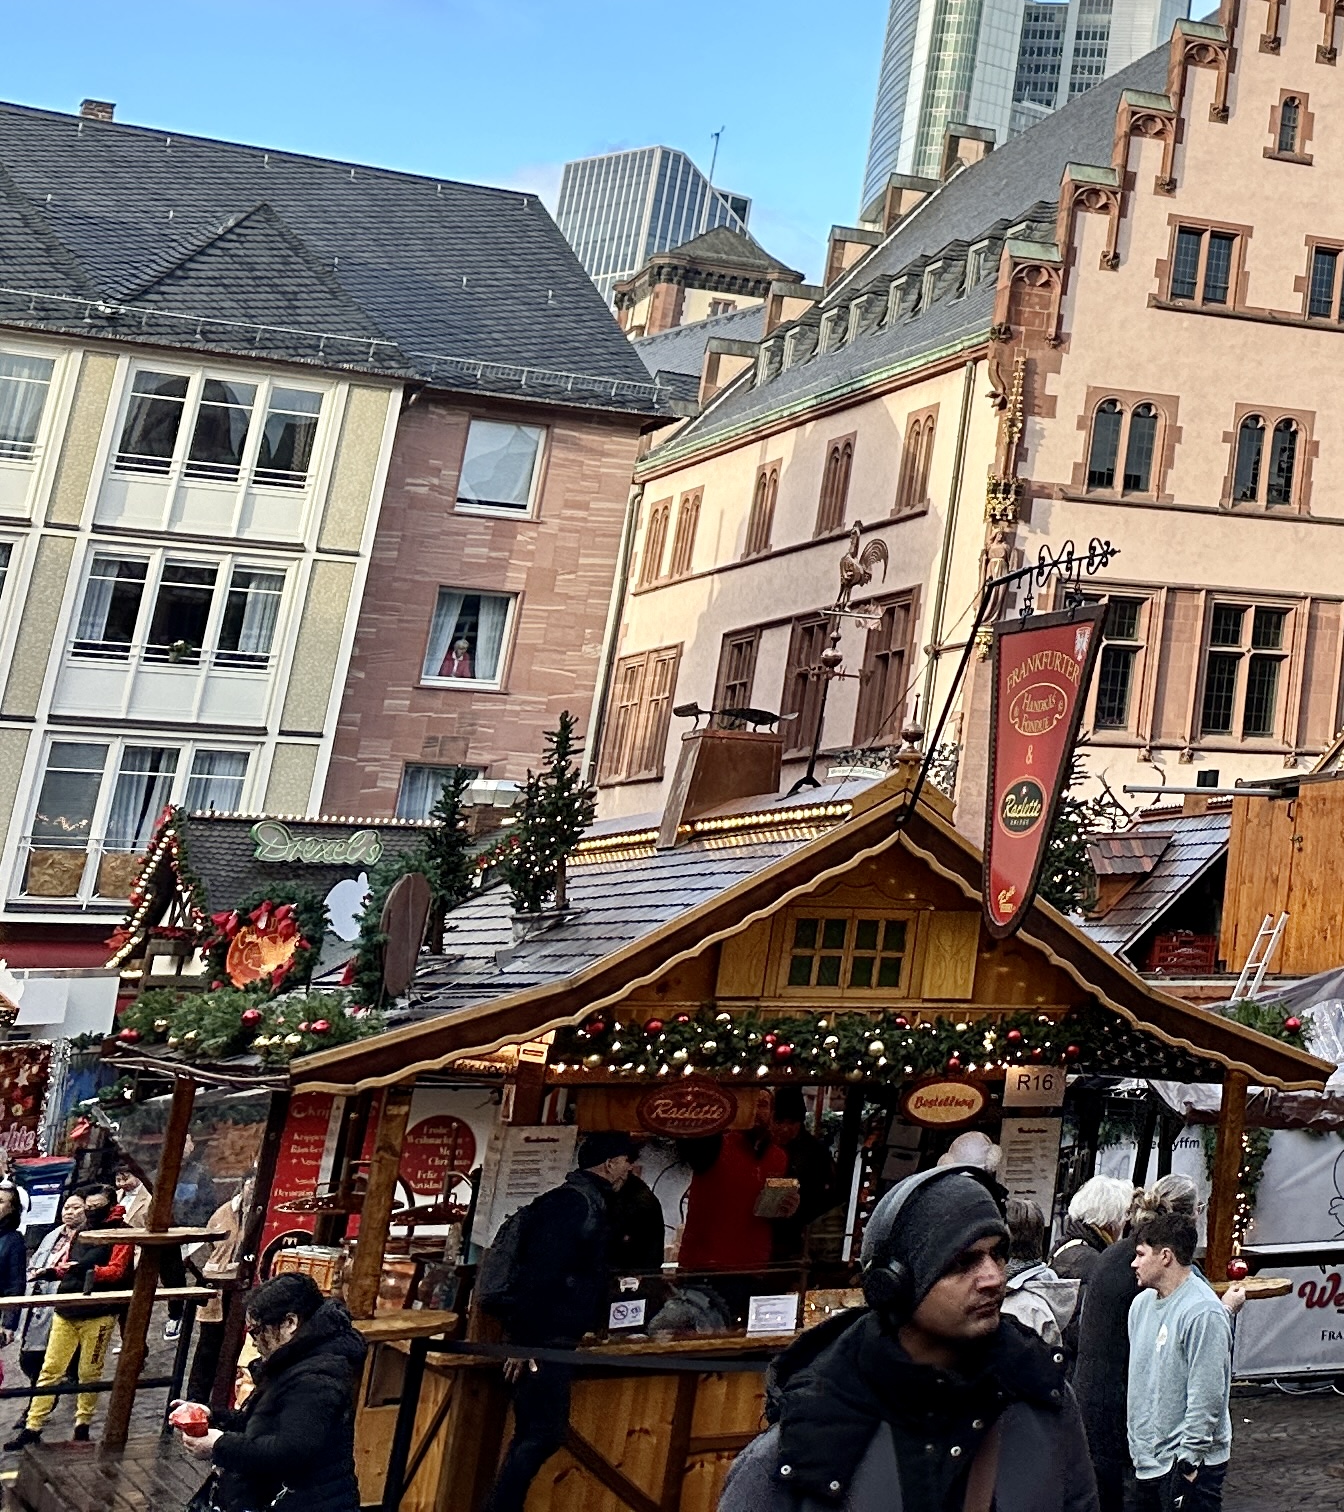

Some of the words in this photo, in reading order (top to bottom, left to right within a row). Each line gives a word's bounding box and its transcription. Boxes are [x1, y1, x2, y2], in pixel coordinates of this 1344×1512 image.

[1006, 650, 1081, 695] FRANKFURTER
[1025, 744, 1033, 765] &
[1002, 794, 1042, 819] Raclette
[255, 821, 381, 863] Drexel's
[1017, 1073, 1054, 1091] R16
[652, 1099, 724, 1120] Raclette
